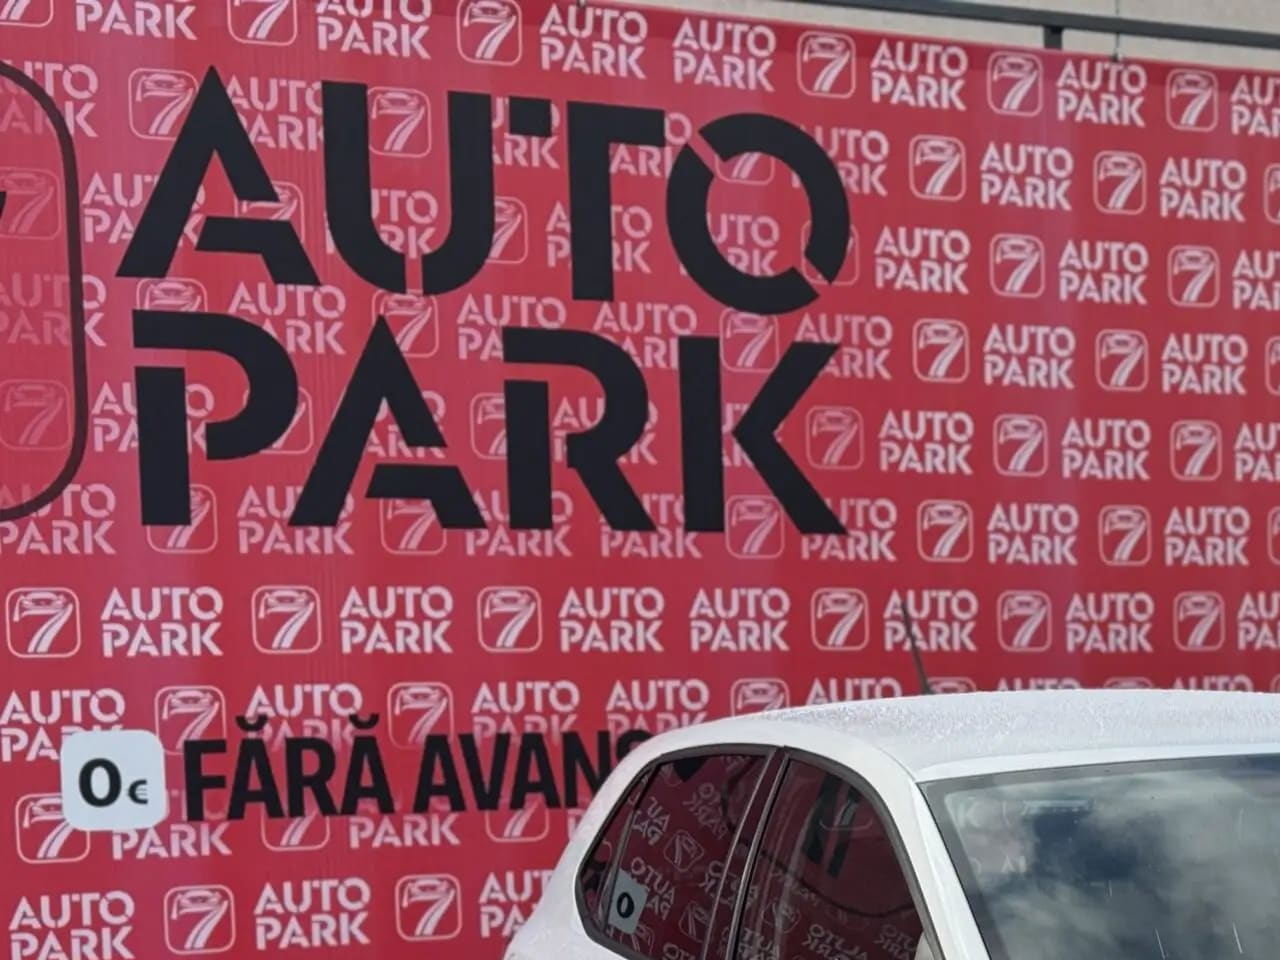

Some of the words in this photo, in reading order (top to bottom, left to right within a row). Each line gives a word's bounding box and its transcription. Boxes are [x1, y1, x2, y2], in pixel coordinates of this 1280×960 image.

[75, 0, 197, 41] PARK
[317, 17, 431, 60] PARK
[539, 7, 649, 46] AUTO
[672, 16, 777, 58] AUTO
[540, 36, 646, 80] PARK
[673, 49, 774, 92] PARK
[870, 37, 969, 78] AUTO
[871, 69, 967, 111] PARK
[1056, 59, 1149, 95] AUTO
[1057, 88, 1145, 128] PARK
[979, 141, 1074, 179] AUTO
[1159, 157, 1247, 191] AUTO
[115, 65, 851, 316] AUTO
[980, 172, 1072, 211] PARK
[1159, 186, 1245, 223] PARK
[874, 225, 971, 262] AUTO
[1058, 239, 1149, 274] AUTO
[875, 256, 969, 295] PARK
[1059, 267, 1148, 305] PARK
[228, 282, 346, 319] AUTO
[457, 293, 567, 329] AUTO
[593, 301, 698, 336] AUTO
[795, 313, 893, 347] AUTO
[983, 323, 1076, 358] AUTO
[1161, 332, 1249, 365] AUTO
[983, 353, 1075, 390] PARK
[1161, 361, 1247, 395] PARK
[131, 309, 850, 536] PARK
[878, 409, 975, 444] AUTO
[1061, 417, 1152, 451] AUTO
[879, 440, 973, 476] PARK
[1062, 447, 1151, 481] PARK
[986, 502, 1079, 535] AUTO
[1163, 505, 1251, 537] AUTO
[238, 520, 355, 555] PARK
[465, 526, 573, 558] PARK
[600, 527, 702, 559] PARK
[801, 531, 896, 562] PARK
[988, 532, 1078, 566] PARK
[1164, 535, 1249, 567] PARK
[100, 585, 224, 622] AUTO
[339, 585, 454, 620] AUTO
[558, 586, 665, 620] AUTO
[689, 587, 791, 620] AUTO
[882, 589, 979, 621] AUTO
[1065, 591, 1155, 623] AUTO
[102, 621, 224, 658] PARK
[340, 619, 453, 655] PARK
[559, 619, 665, 653] PARK
[690, 619, 790, 653] PARK
[884, 619, 977, 652] PARK
[1065, 621, 1153, 653] PARK
[0, 687, 126, 726] AUTO
[245, 682, 364, 719] AUTO
[471, 680, 580, 714] AUTO
[605, 678, 710, 713] AUTO
[184, 713, 395, 823] FĂRĂ
[112, 822, 232, 860] PARK
[350, 812, 461, 849] PARK
[253, 876, 372, 916] AUTO
[479, 870, 553, 905] AUT
[8, 890, 135, 931] AUTO
[255, 910, 371, 951] PARK
